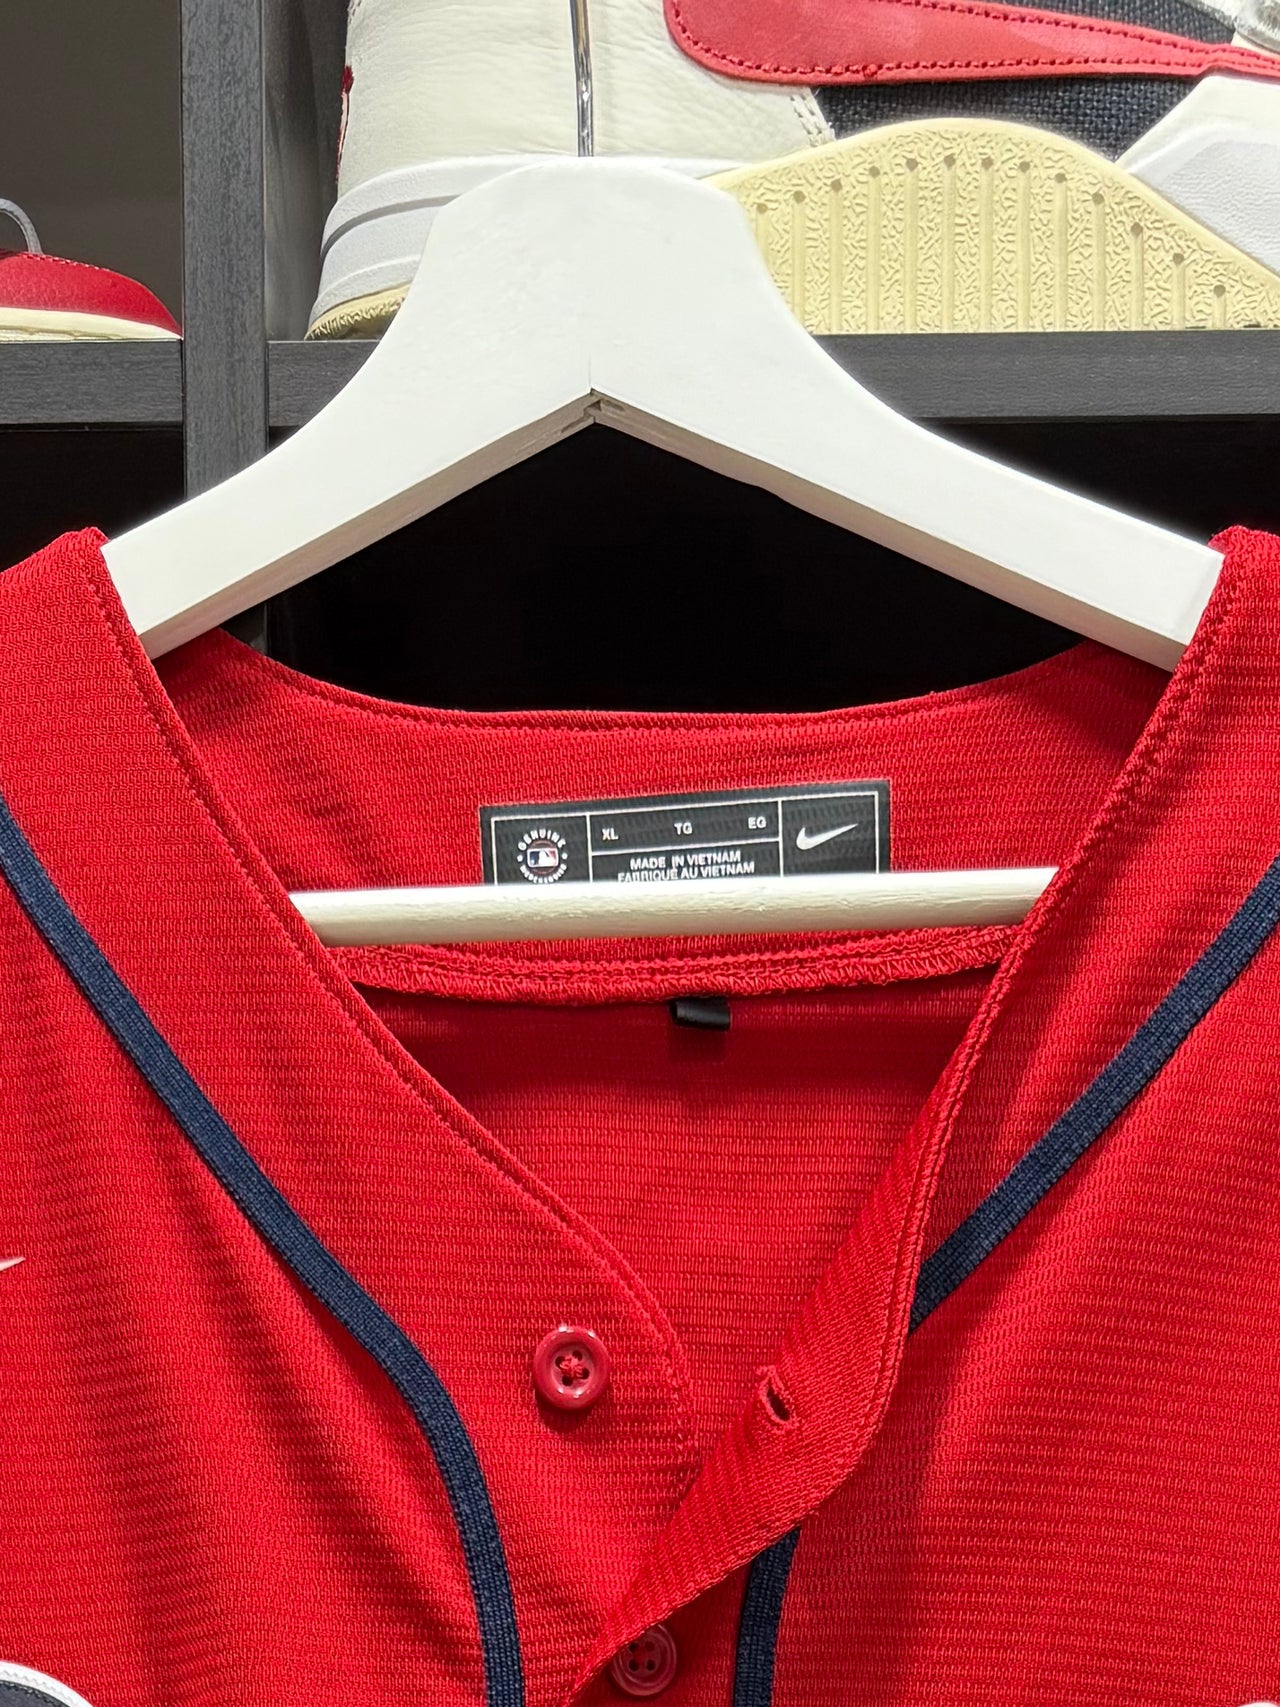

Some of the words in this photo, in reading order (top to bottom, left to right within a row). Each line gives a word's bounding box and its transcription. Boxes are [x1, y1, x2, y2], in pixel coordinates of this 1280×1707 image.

[674, 822, 693, 835] TG
[748, 816, 767, 829] EG
[602, 828, 619, 840] XL
[630, 856, 666, 871] MADE
[672, 854, 685, 868] IN
[687, 850, 741, 866] VIETNAM
[681, 866, 699, 880] AU
[699, 861, 755, 878] VIETNAM
